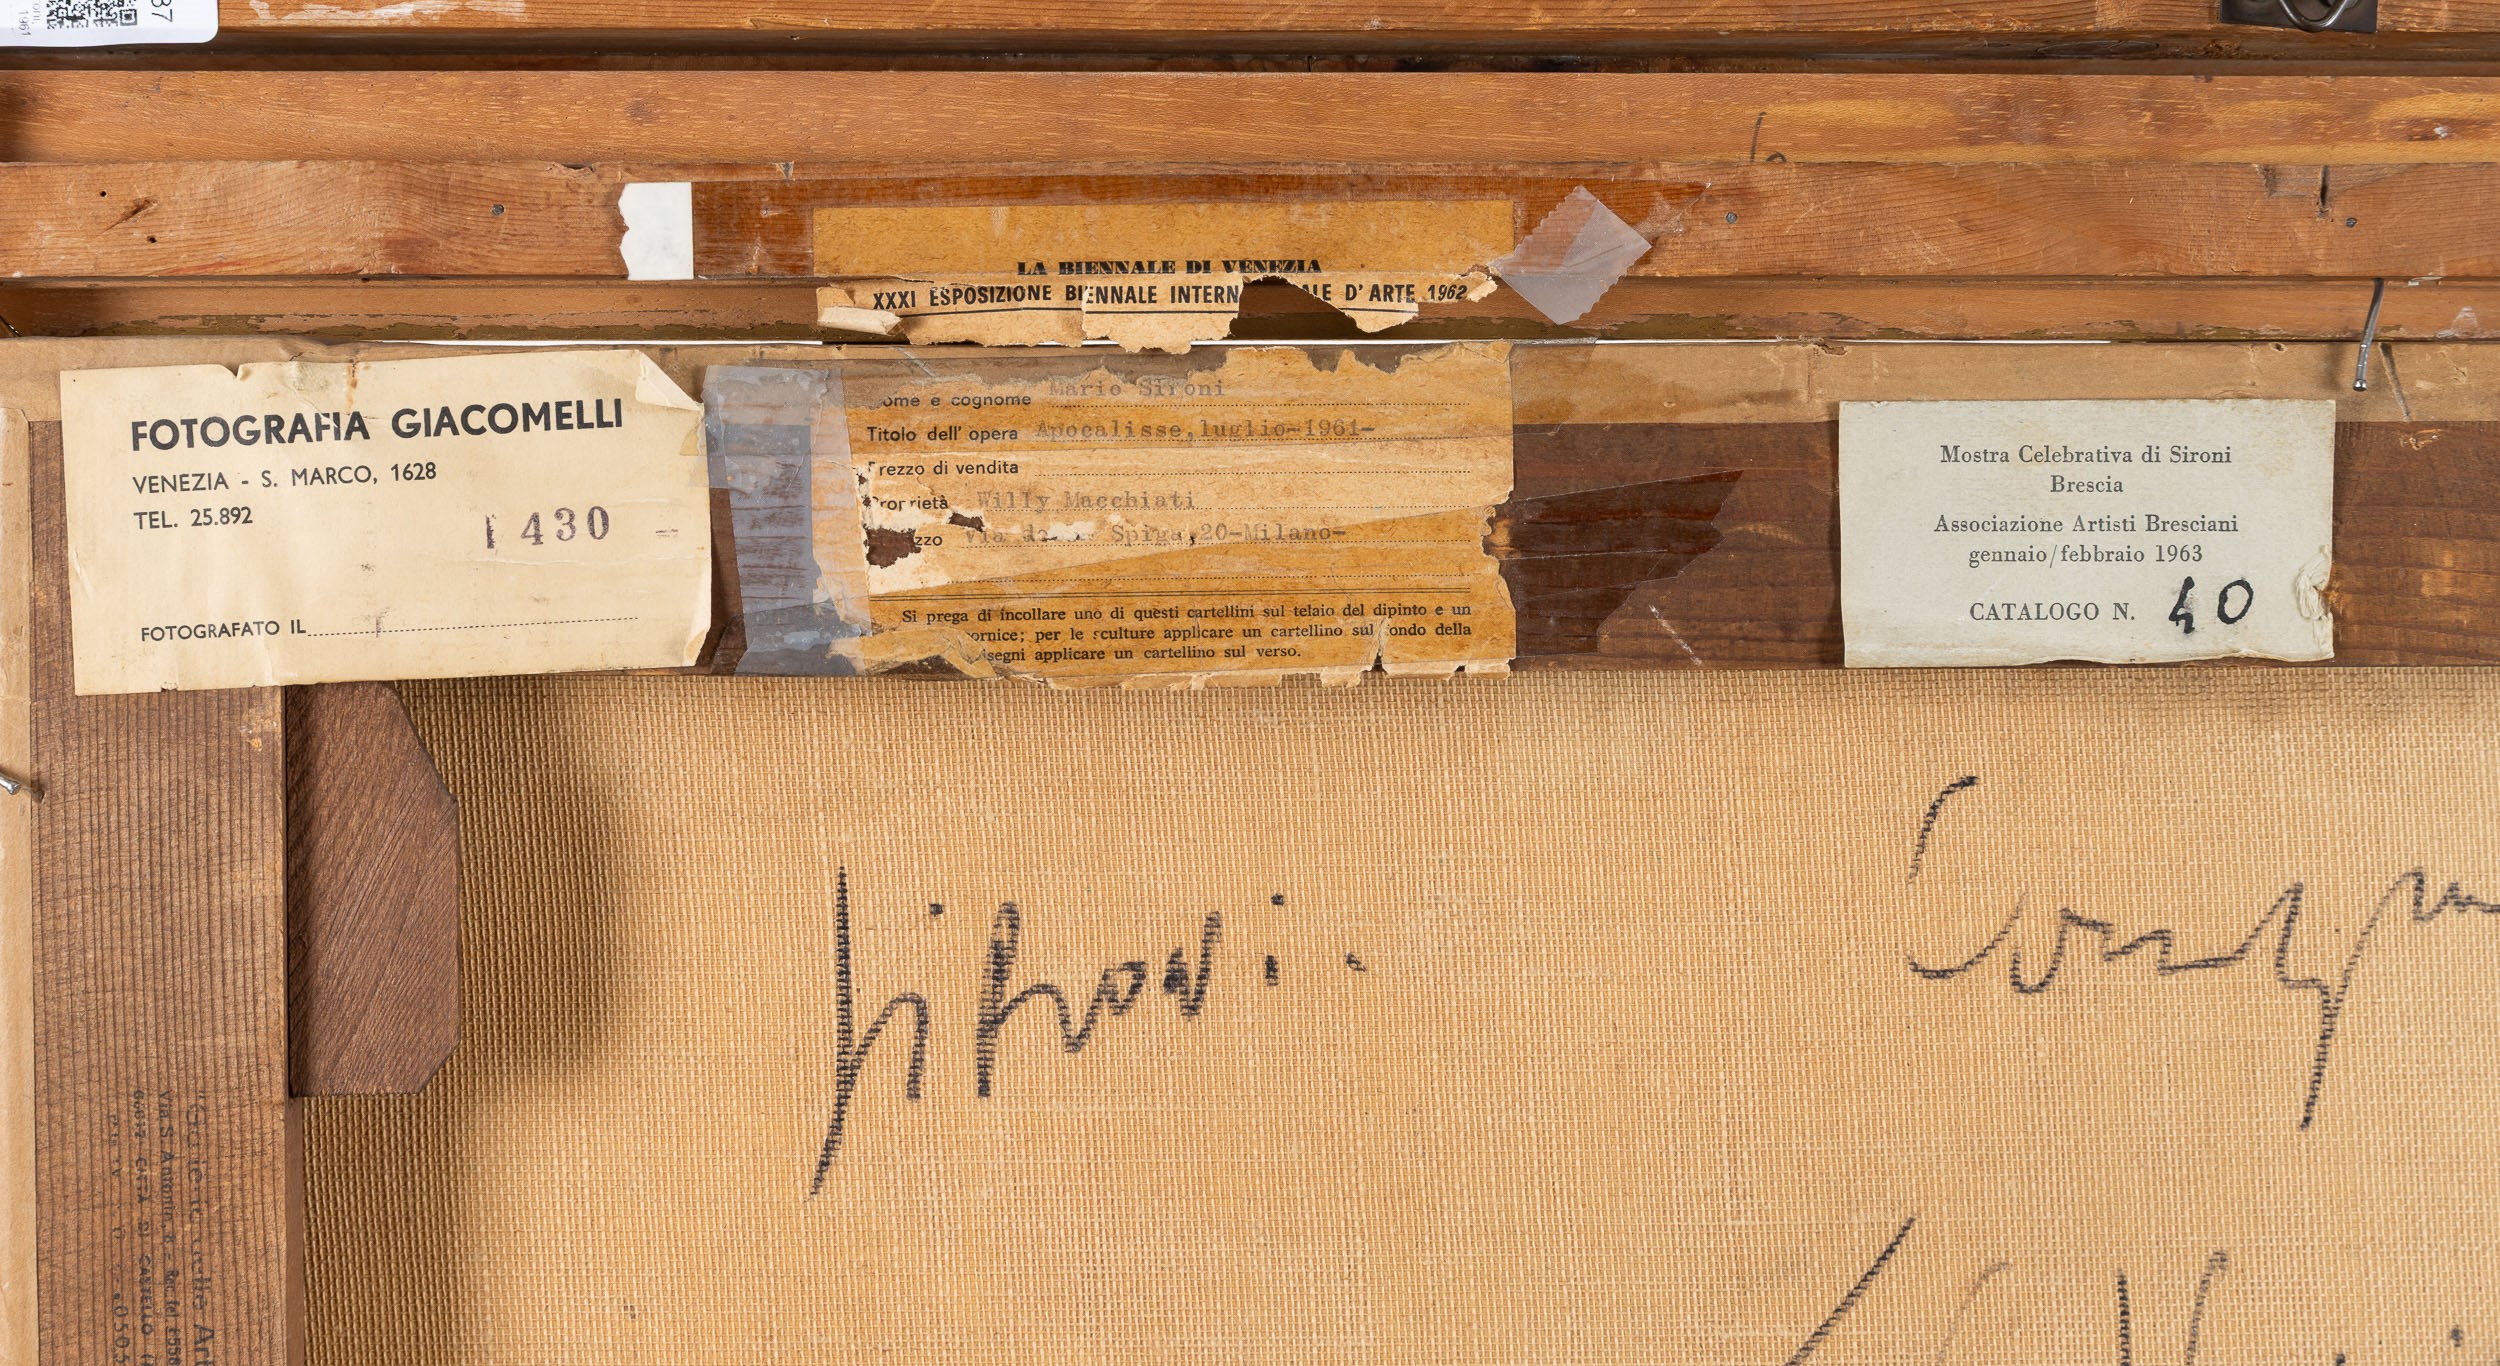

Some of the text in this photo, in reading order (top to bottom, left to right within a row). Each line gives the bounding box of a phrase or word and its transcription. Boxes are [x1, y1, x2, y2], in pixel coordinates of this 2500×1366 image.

[1017, 259, 1322, 276] LA BIENNALE DI VENEZIA
[873, 291, 916, 310] XXXI
[930, 285, 1052, 306] ESPOSIZIONE
[1065, 285, 1157, 304] BIENNALE
[1427, 284, 1468, 300] 1962
[1049, 380, 1225, 397] Mario Sironi
[883, 395, 1031, 409] ome e cognome
[132, 398, 624, 452] FOTOGRAFIA GIACOMELLI
[867, 425, 1018, 444] Titolo dell' opera
[1940, 444, 2233, 465] Mostra Celebrativa di Sironi
[933, 460, 949, 475] di
[956, 461, 1019, 475] vendita
[133, 471, 229, 495] VENEZIA
[261, 466, 279, 488] S.
[291, 463, 378, 487] MARCO,
[390, 462, 437, 482] 1628
[2050, 474, 2124, 494] Brescia
[872, 495, 949, 512] rorietà
[976, 491, 1195, 513] Willy Macchiati
[134, 507, 253, 531] TEL. 25.892
[1933, 514, 2239, 533] Associazione Artisti Bresciani
[1968, 544, 2203, 568] gennaio/febbraio 1963
[902, 603, 1472, 625] Si prega di incollare uno di questi cartellini sul telaio del dipinto e un
[1969, 602, 2136, 622] CATALOGO N.
[2168, 575, 2254, 634] 40
[140, 619, 307, 643] FOTOGRAFATO IL
[1035, 631, 1061, 644] per
[1071, 628, 1084, 640] le
[1163, 626, 1234, 643] applicare
[1243, 628, 1262, 638] un
[1271, 625, 1343, 638] cartellino
[1352, 624, 1374, 636] sul
[1387, 623, 1426, 636] ondo
[1435, 623, 1472, 636] della
[982, 645, 1301, 663] isegni applicare un cartellino sul verso.
